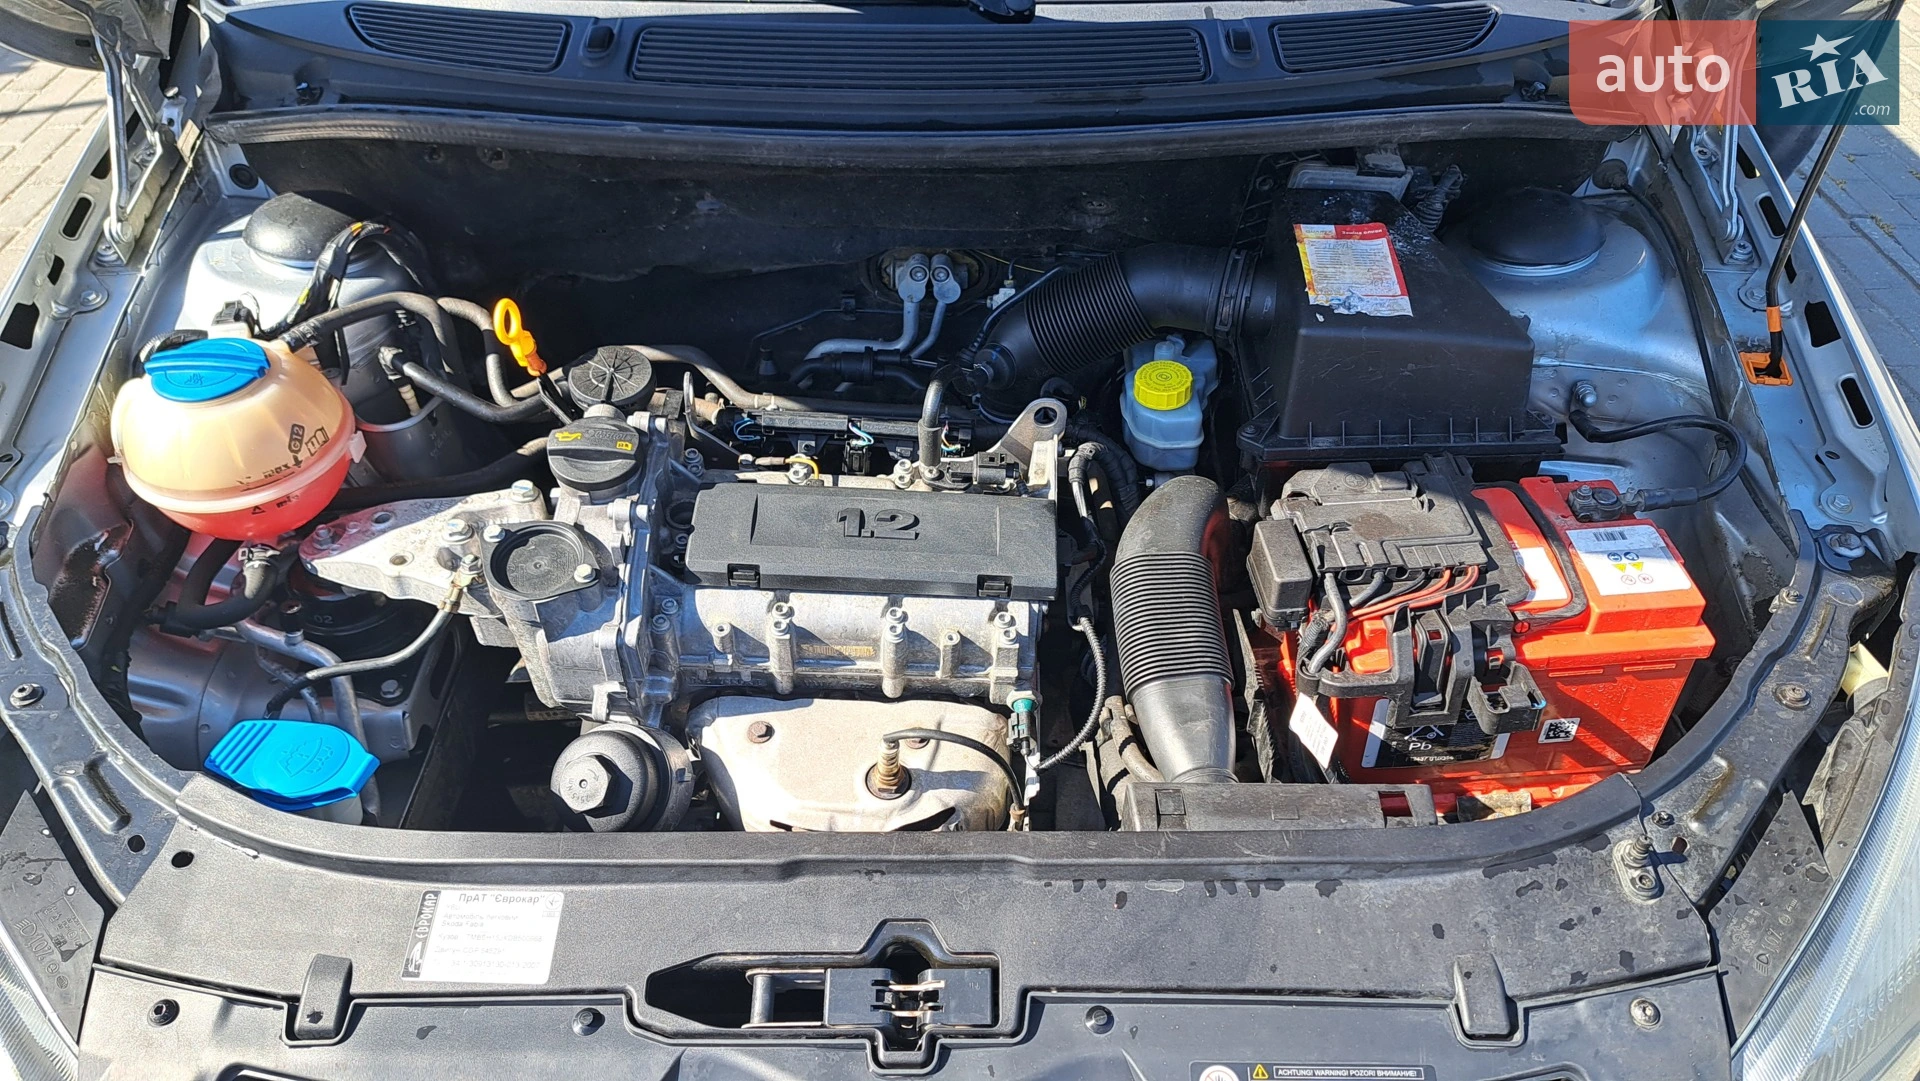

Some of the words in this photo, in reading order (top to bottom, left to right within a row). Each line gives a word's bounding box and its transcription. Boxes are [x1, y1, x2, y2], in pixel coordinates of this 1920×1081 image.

[836, 508, 920, 540] 1.2
[1408, 741, 1432, 751] Pb
[459, 893, 488, 904] ПрАТ
[490, 893, 545, 905] "Єврокар"
[415, 893, 437, 938] ЄВРОКАР
[1313, 1069, 1349, 1077] WARNING!
